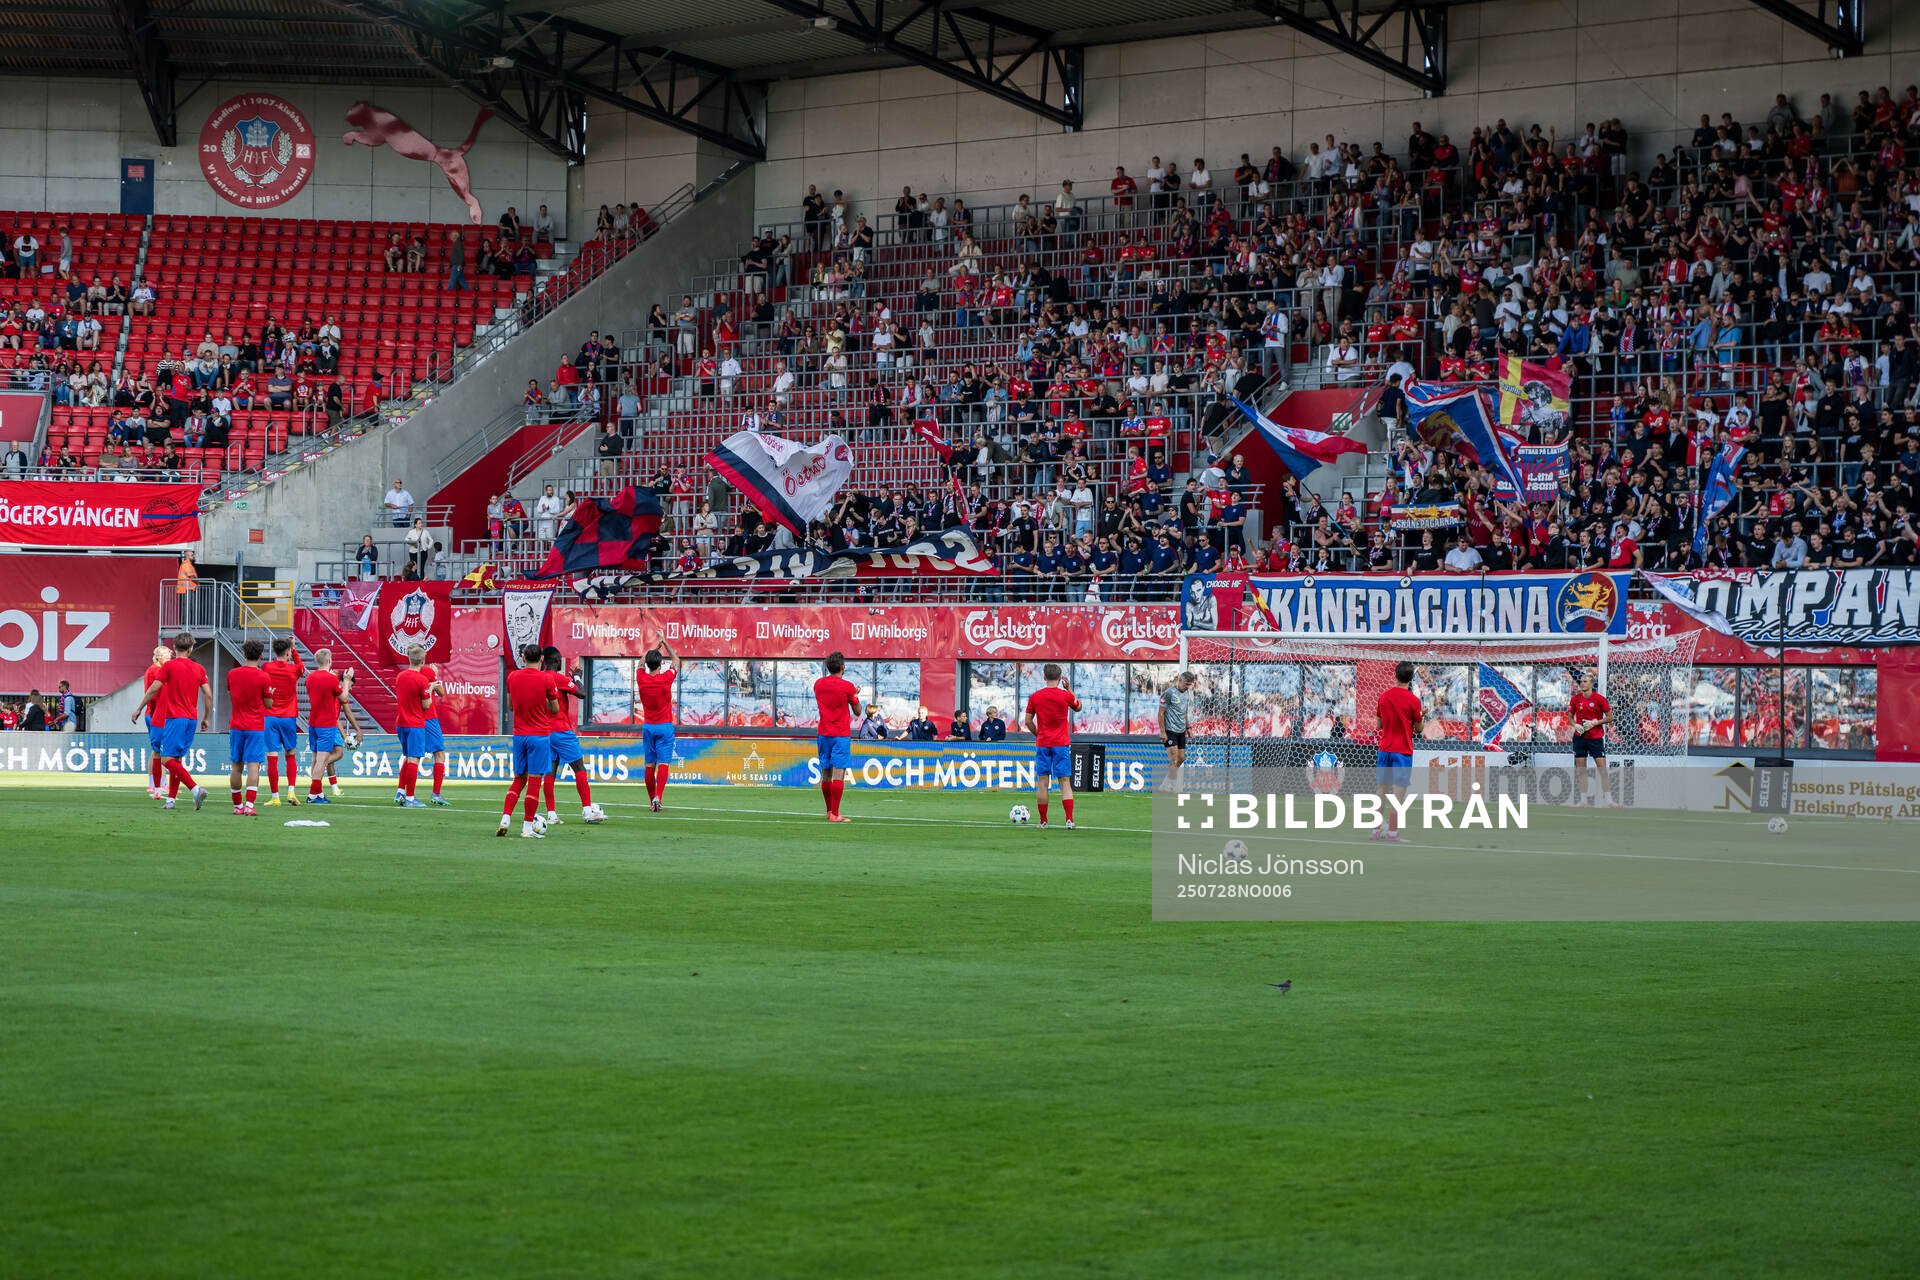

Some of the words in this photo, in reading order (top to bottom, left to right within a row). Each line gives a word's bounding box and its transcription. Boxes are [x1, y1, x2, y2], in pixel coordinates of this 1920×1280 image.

[211, 102, 241, 129] Medlem
[250, 97, 306, 133] 1907-klubben
[202, 144, 217, 153] 20
[297, 147, 309, 156] 23
[213, 176, 239, 199] satsar
[239, 193, 253, 204] på
[280, 166, 308, 197] framtid
[1205, 580, 1230, 588] CHOOSE
[1231, 580, 1243, 588] HIF
[1673, 569, 1920, 632] OMPAN
[587, 624, 641, 641] Wihlborgs
[682, 624, 738, 641] Wihlborgs
[772, 623, 830, 642] Wihlborgs
[867, 624, 928, 642] Wihlborgs
[964, 610, 1048, 646] Carlsberg
[445, 681, 497, 698] Wihlborgs
[38, 741, 135, 772] MÖTEN
[351, 751, 393, 776] SPA
[457, 745, 515, 778] MÖT
[808, 757, 857, 785] SA
[862, 757, 925, 787] OCH
[933, 752, 1036, 789] MÖTEN
[1074, 754, 1083, 788] SELECT
[1092, 754, 1101, 788] SELECT
[669, 772, 702, 780] SEASIDE
[726, 771, 747, 781] ÅHUS
[1759, 769, 1771, 808] SELECT
[1781, 771, 1790, 809] SELECT
[1793, 800, 1893, 819] Helsingborg
